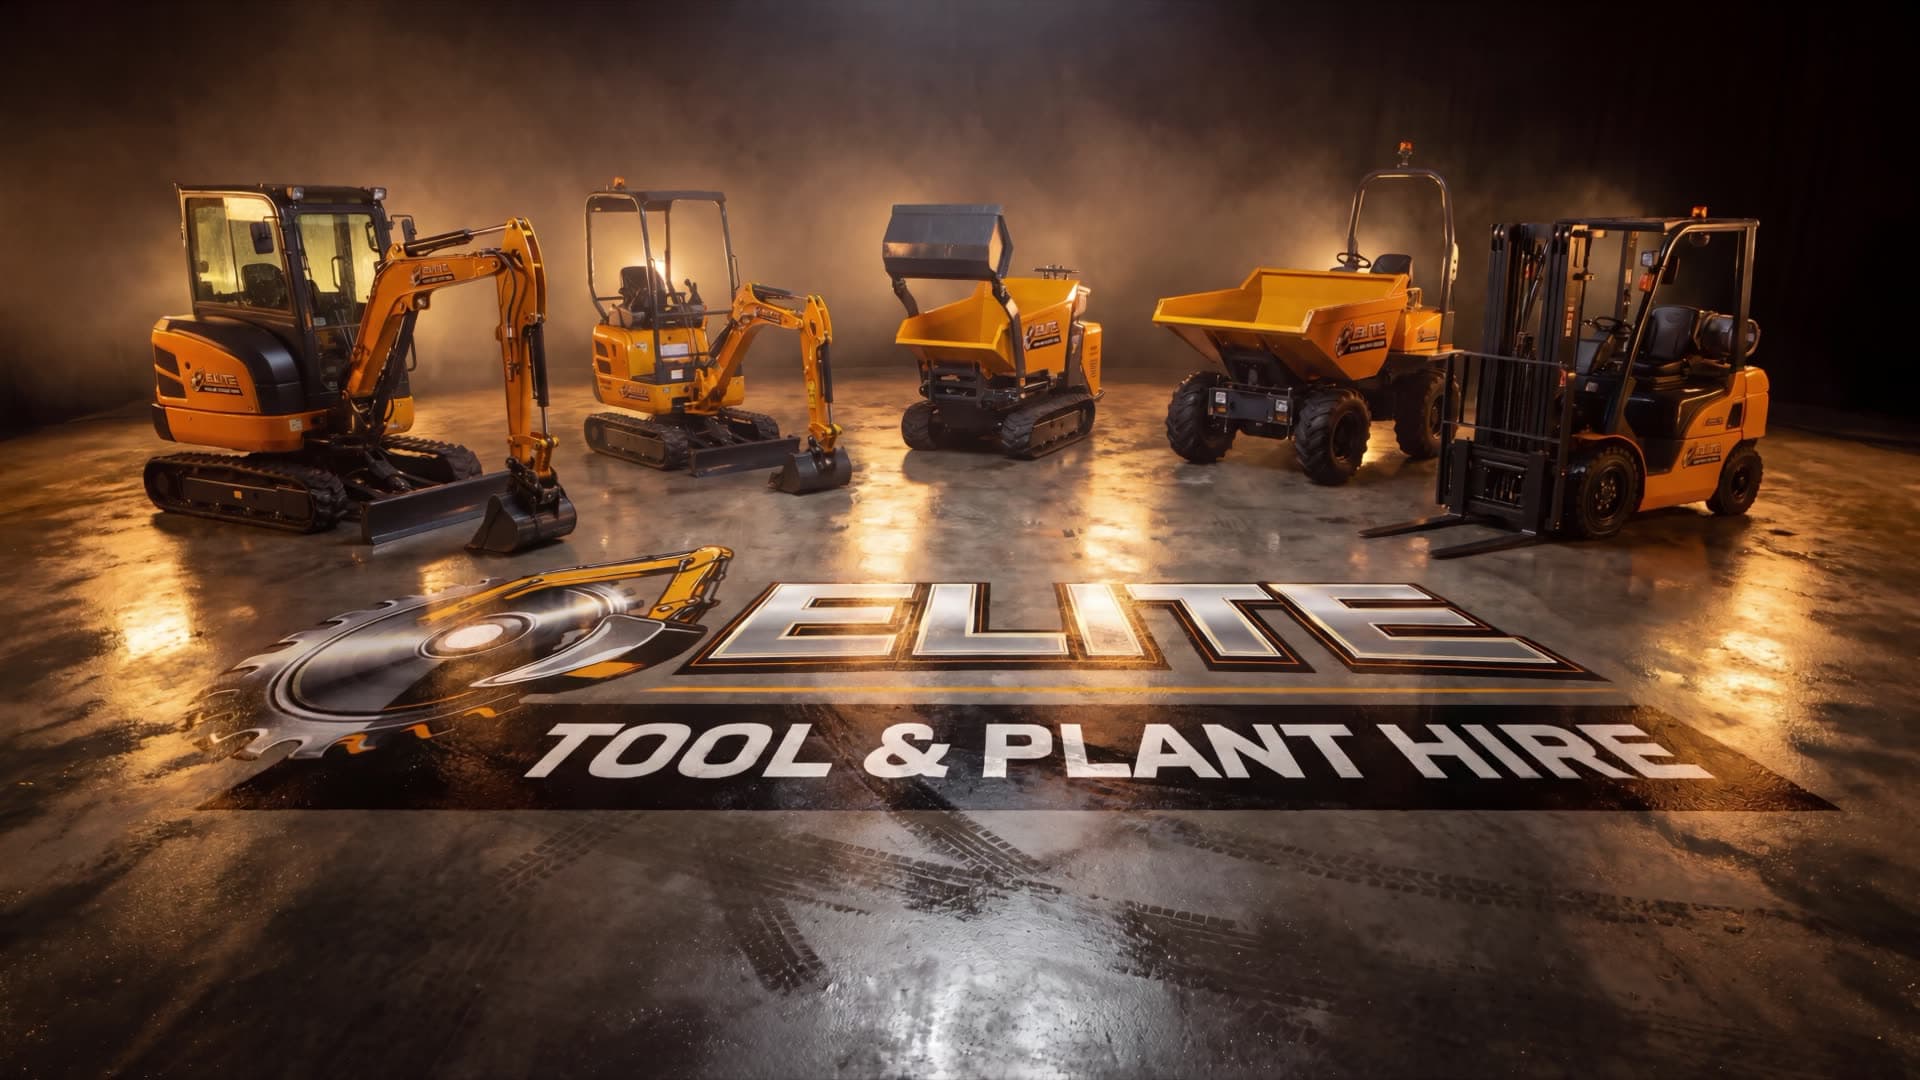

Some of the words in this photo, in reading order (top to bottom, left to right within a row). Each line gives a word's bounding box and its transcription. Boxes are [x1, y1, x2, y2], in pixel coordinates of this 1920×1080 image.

[690, 582, 1585, 672] ELITE
[523, 723, 832, 779] TOOL
[863, 723, 949, 779] &
[982, 723, 1365, 779] PLANT
[1375, 723, 1716, 780] HIRE
